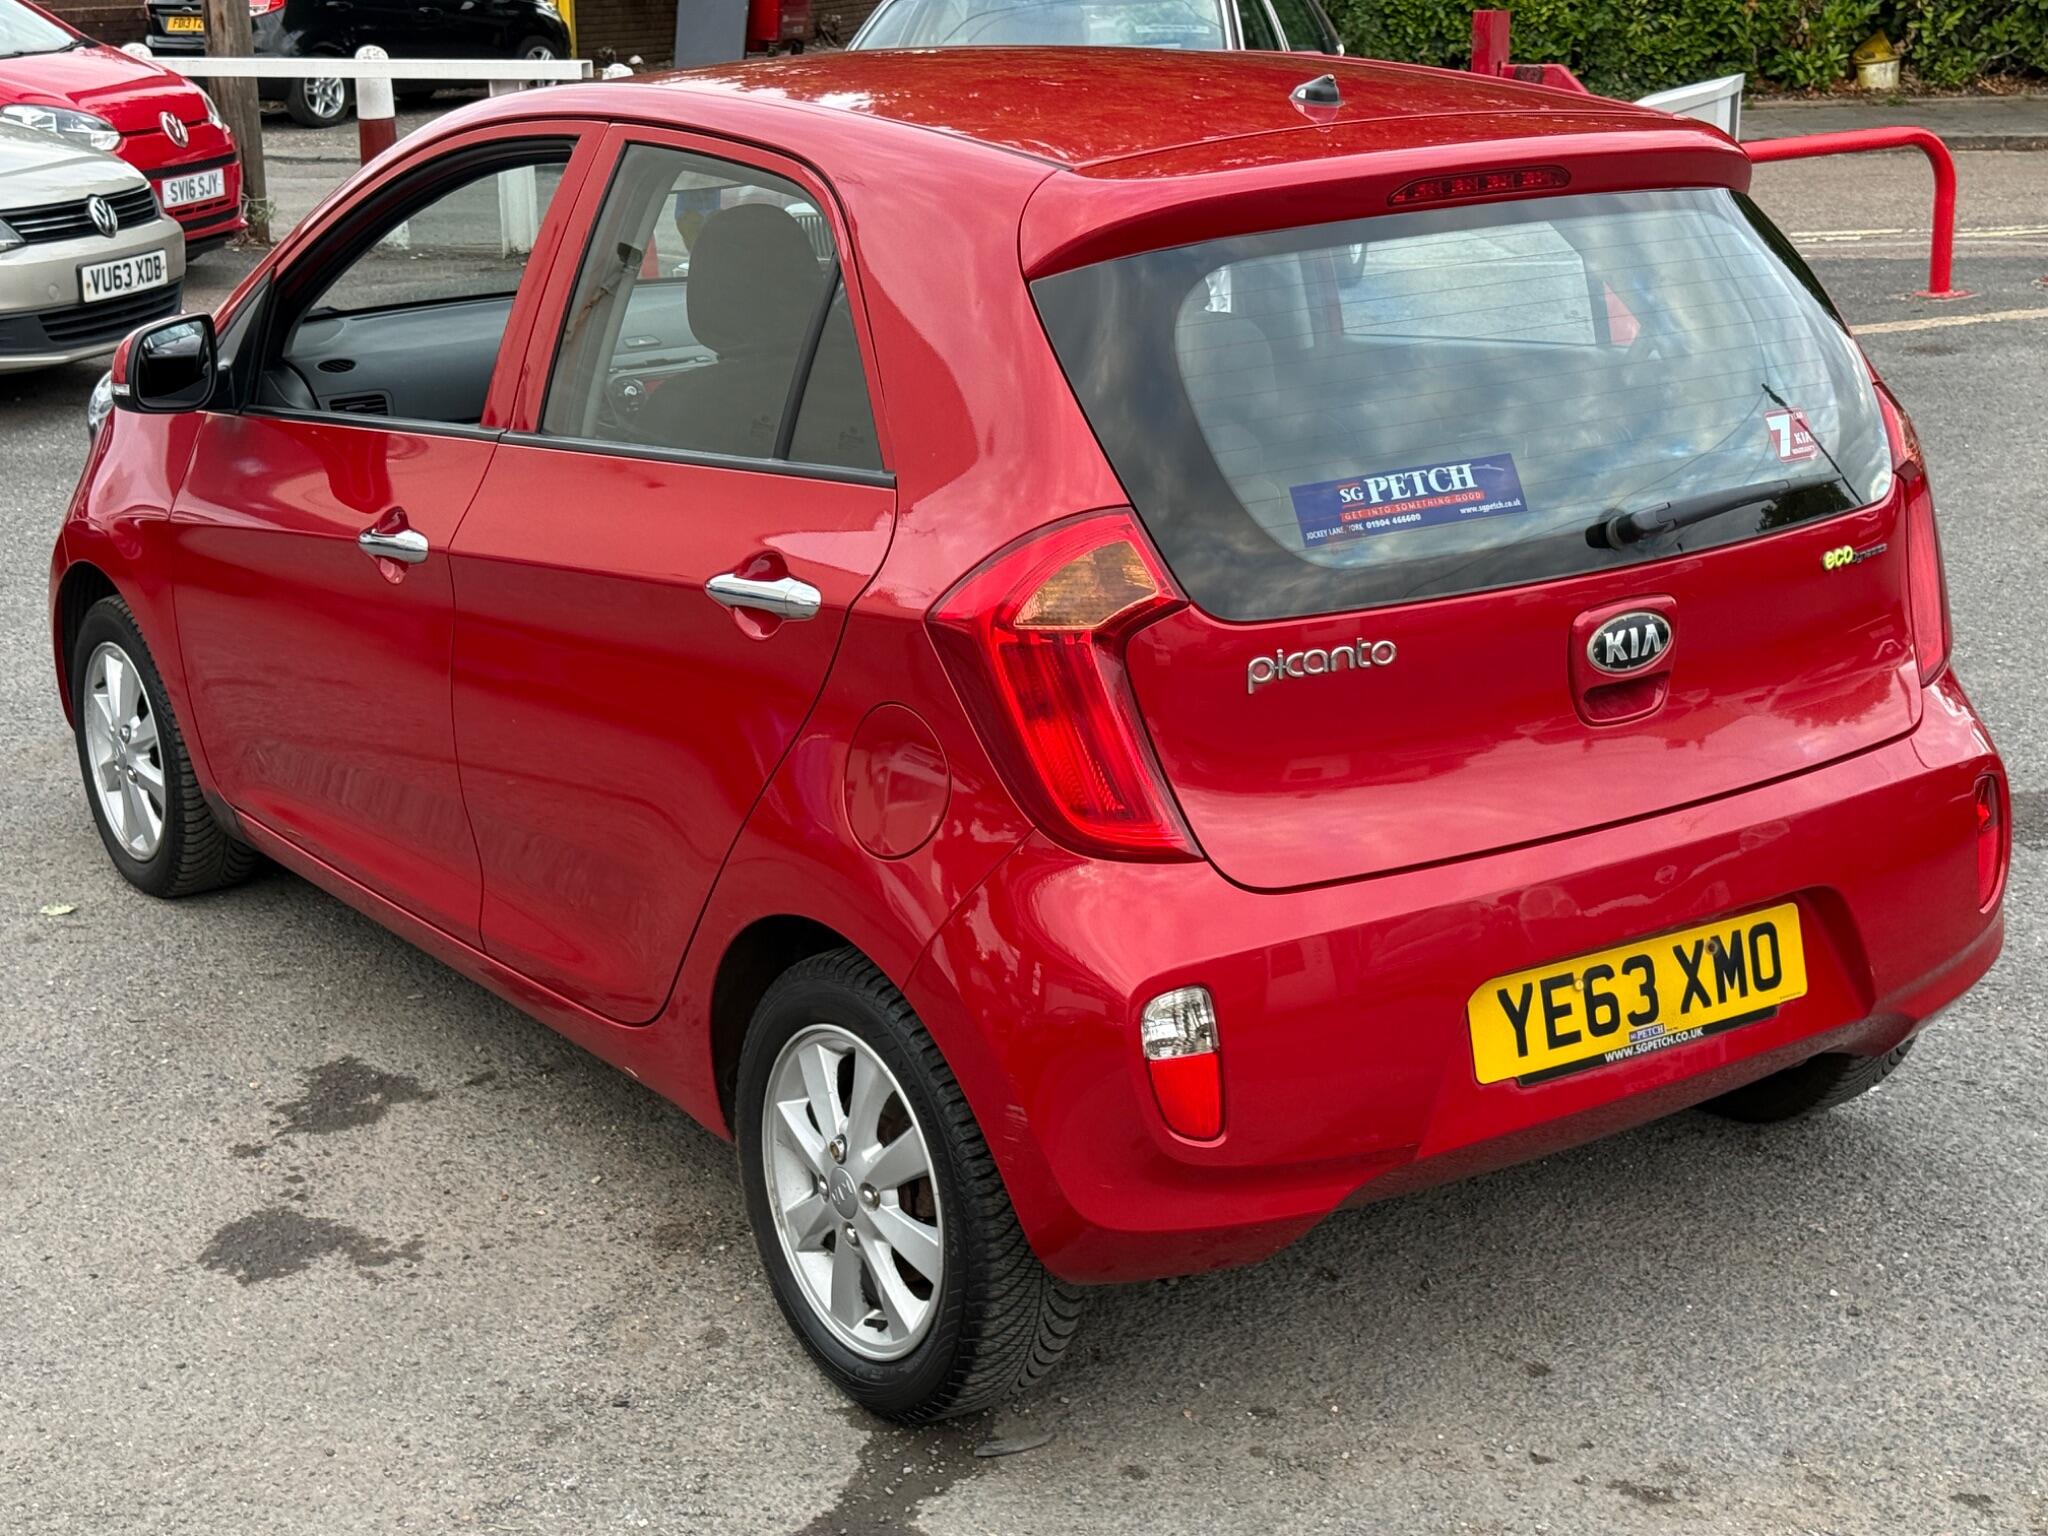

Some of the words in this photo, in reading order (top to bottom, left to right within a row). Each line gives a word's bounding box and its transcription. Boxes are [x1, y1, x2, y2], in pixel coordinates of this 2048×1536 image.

[170, 179, 196, 202] SV16
[198, 173, 218, 196] SJY
[90, 262, 132, 294] VU63
[136, 255, 162, 285] XDB
[1766, 414, 1791, 457] 7
[1794, 431, 1812, 444] KIA
[1339, 486, 1364, 503] SG
[1363, 463, 1478, 504] PETCH
[1344, 510, 1362, 520] GET
[1368, 507, 1391, 516] INTO
[1396, 496, 1451, 512] SOMETHING
[1455, 491, 1481, 502] GOOD
[1460, 498, 1522, 514] www.sgpetch.co.uk
[1306, 530, 1328, 541] JOCKEY
[1366, 518, 1390, 529] 01904
[1604, 623, 1662, 664] KIA
[1247, 637, 1397, 695] picanto
[1496, 954, 1660, 1058] YE63
[1672, 921, 1783, 1015] XMO
[1605, 1027, 1704, 1063] WWW.SGPETCH.CO.UK
[1636, 1025, 1664, 1039] PETCH
